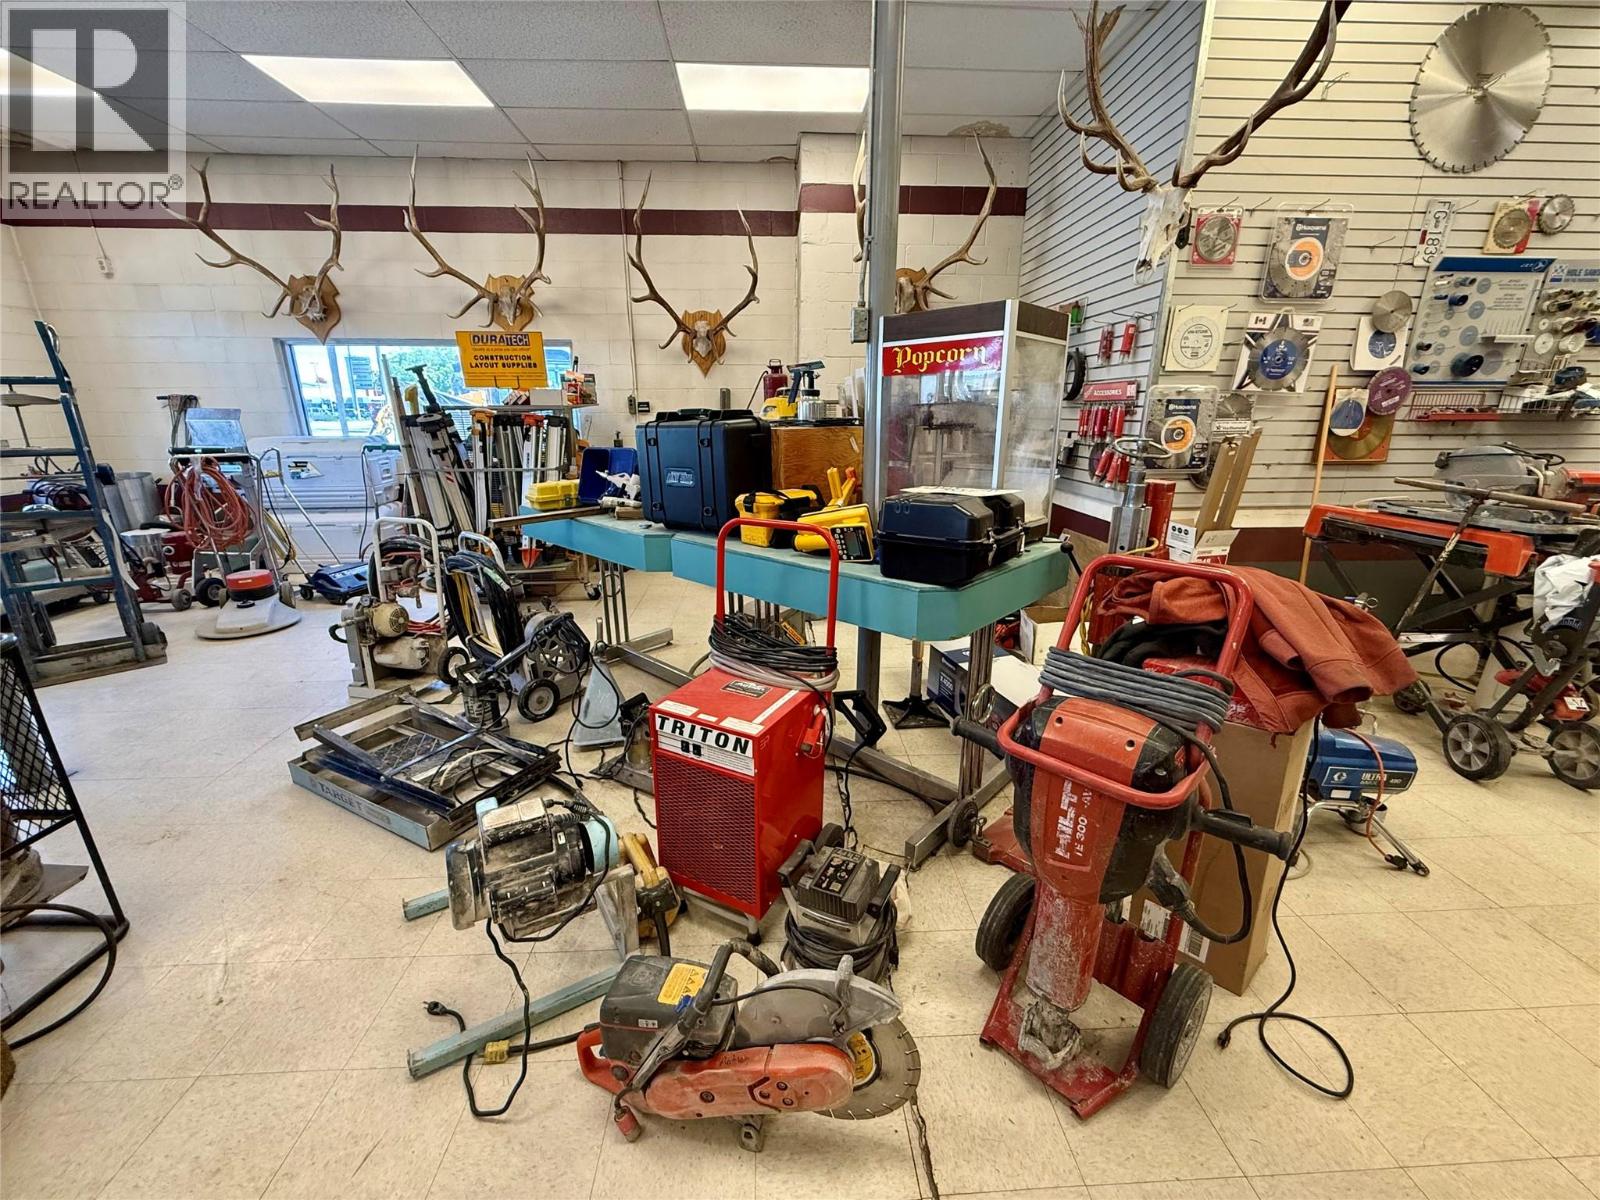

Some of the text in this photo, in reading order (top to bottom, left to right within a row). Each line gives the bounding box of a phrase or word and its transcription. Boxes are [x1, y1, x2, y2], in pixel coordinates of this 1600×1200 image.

[472, 334, 529, 346] DURATECH
[892, 344, 987, 374] Popcorn
[1093, 388, 1122, 396] ACCESSORIES
[657, 715, 750, 755] TRITON
[319, 782, 362, 811] TARGET
